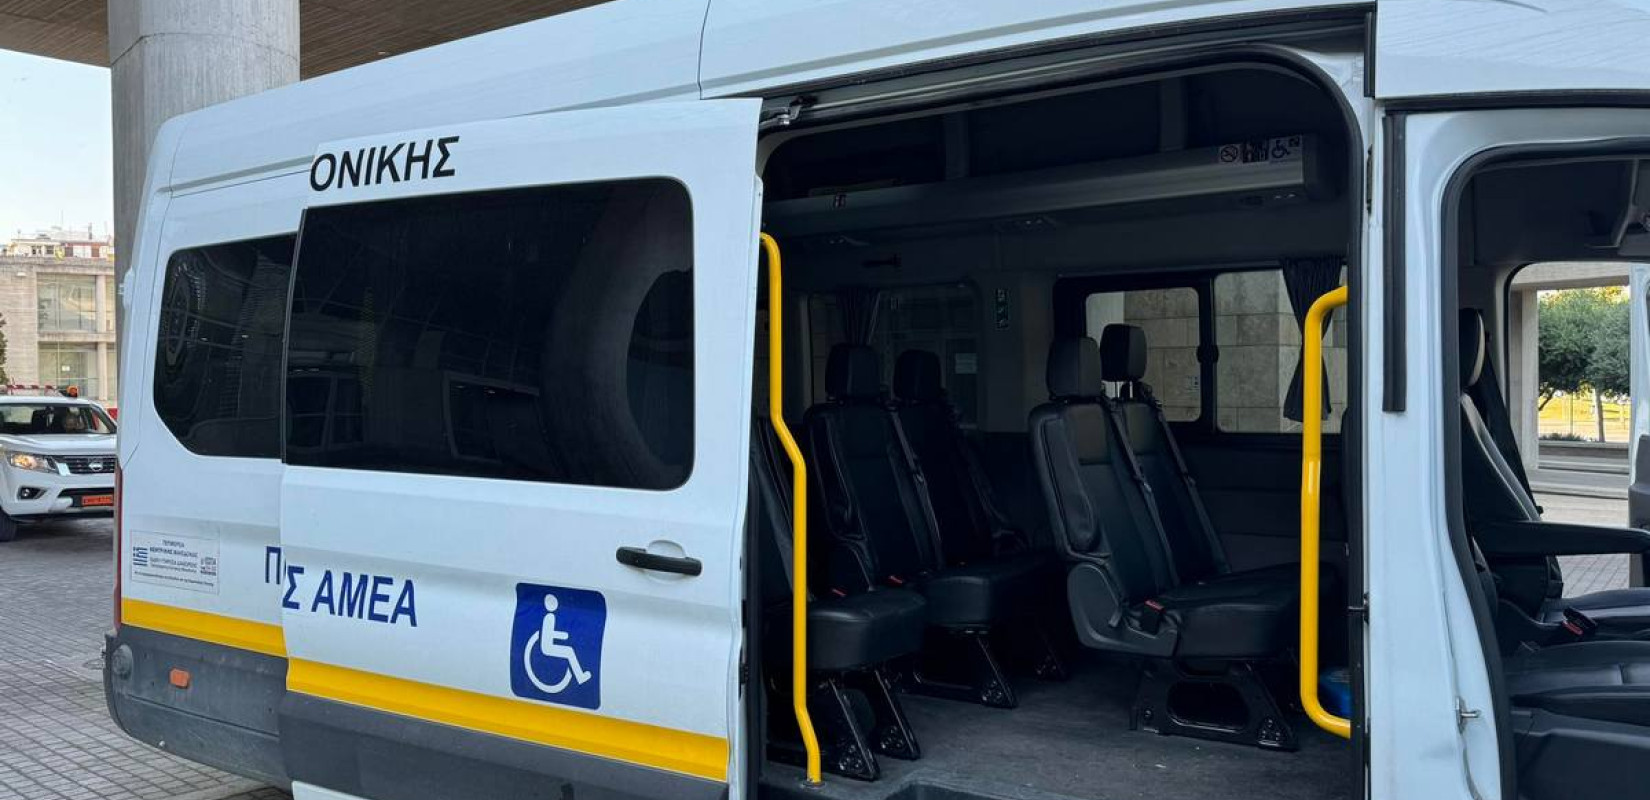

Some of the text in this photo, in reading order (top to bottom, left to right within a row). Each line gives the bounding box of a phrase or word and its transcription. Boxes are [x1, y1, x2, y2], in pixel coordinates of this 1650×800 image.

[310, 136, 460, 191] ΟΝΙΚΗΣ
[282, 563, 418, 627] Σ ΑΜΕΑ
